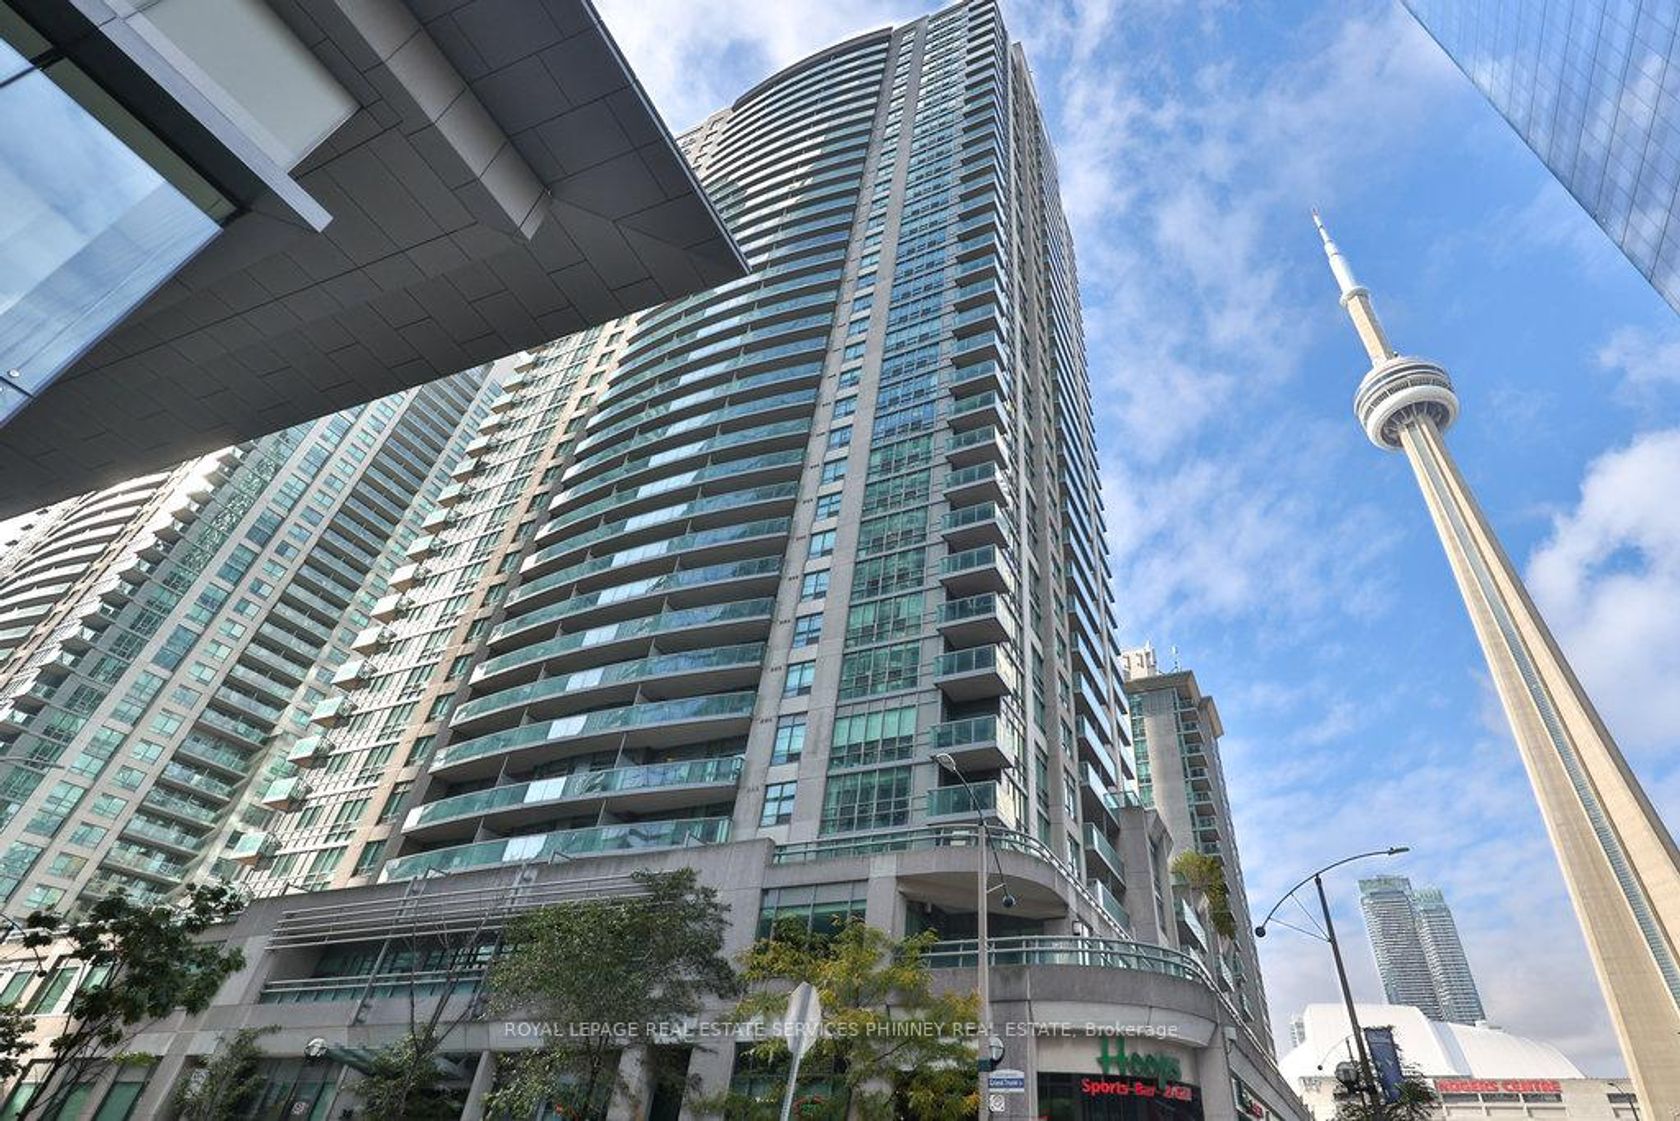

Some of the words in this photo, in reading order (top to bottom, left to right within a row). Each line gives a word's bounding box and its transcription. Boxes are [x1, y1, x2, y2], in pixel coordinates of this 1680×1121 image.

[1081, 1078, 1129, 1096] Sports
[1436, 1079, 1498, 1092] ROGERS
[1501, 1079, 1562, 1092] CENTRE
